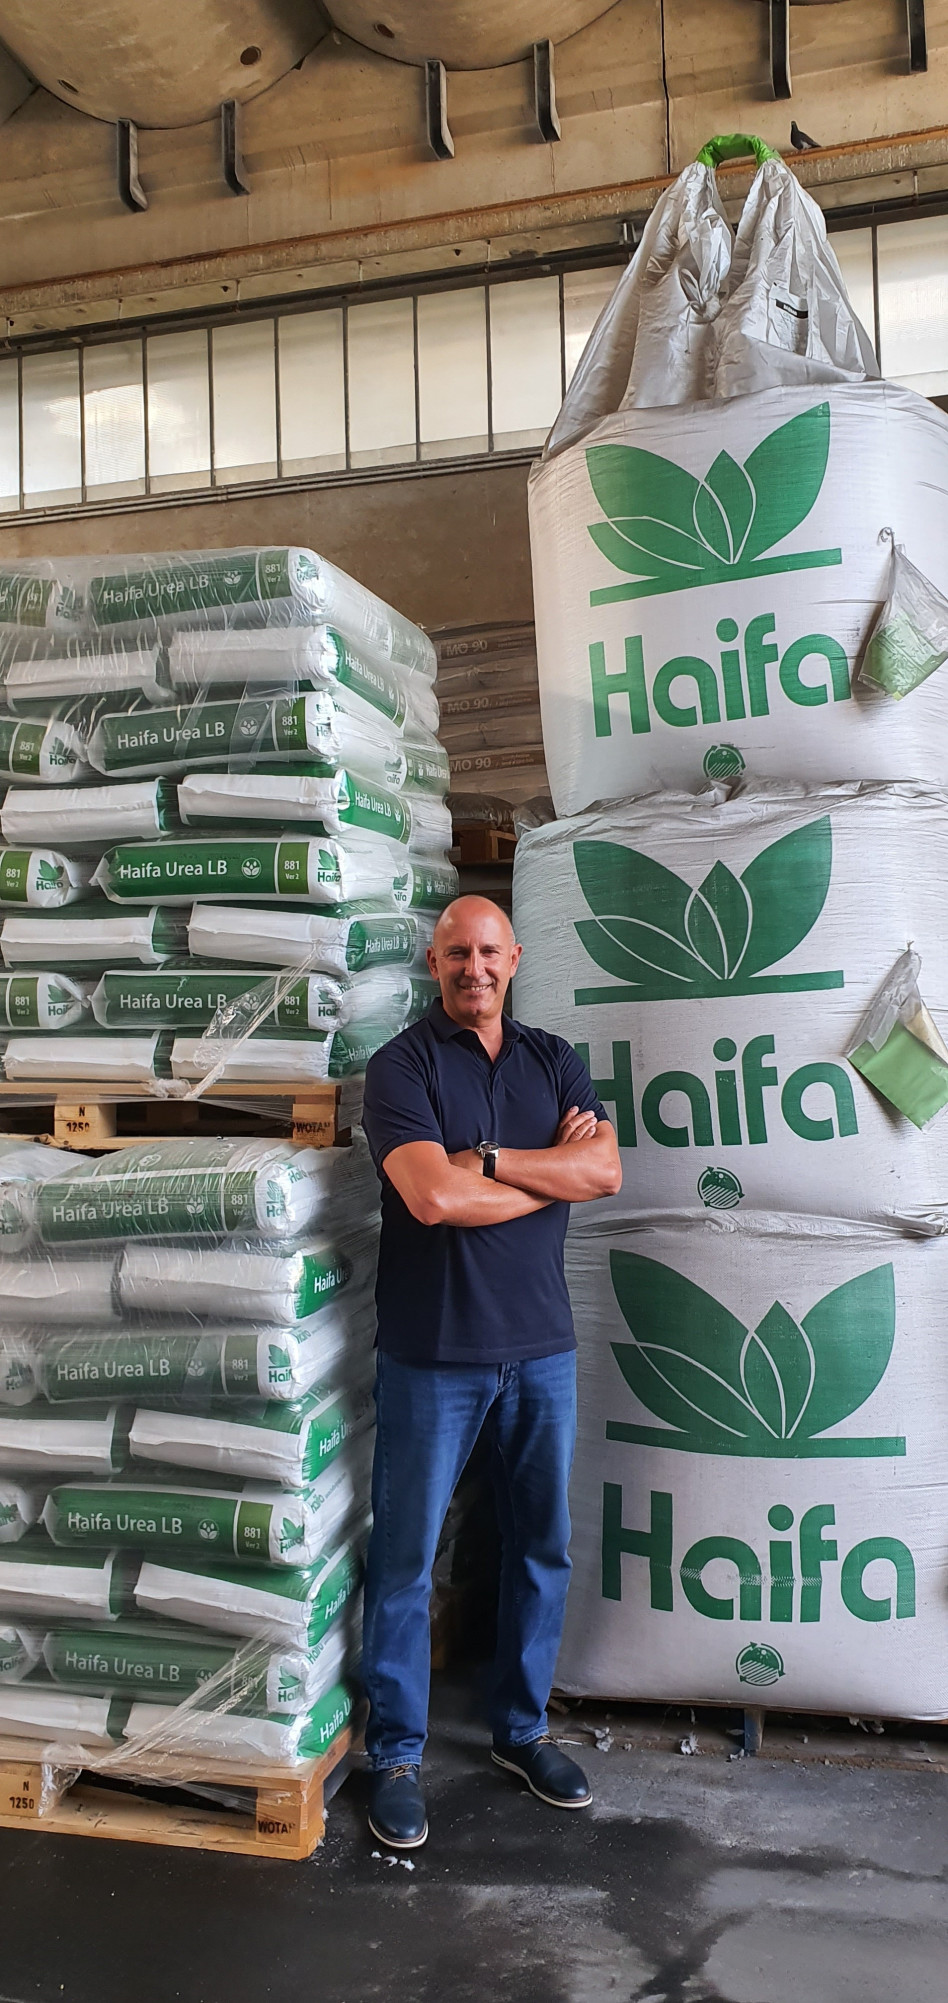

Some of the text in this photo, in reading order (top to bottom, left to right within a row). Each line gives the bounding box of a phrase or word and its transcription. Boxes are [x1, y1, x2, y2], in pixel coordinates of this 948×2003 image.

[265, 564, 280, 573] 881
[103, 574, 209, 604] Haifa Urea LB
[447, 643, 468, 657] MO
[472, 640, 488, 652] 90
[588, 612, 851, 737] Haifa
[447, 700, 470, 713] MO
[473, 697, 489, 709] 90
[282, 716, 298, 726] 881
[117, 722, 225, 749] Haifa Urea LB
[20, 741, 35, 751] 881
[450, 760, 472, 772] MO
[475, 757, 492, 769] 90
[355, 791, 391, 817] Haifa Urea LB
[6, 868, 21, 878] 881
[120, 860, 227, 880] Haifa Urea LB
[284, 861, 300, 871] 881
[365, 938, 381, 954] Haifa
[382, 938, 393, 951] Urea
[15, 996, 30, 1006] 881
[120, 993, 227, 1009] Haifa Urea LB
[284, 996, 300, 1006] 881
[575, 1034, 859, 1148] Haifa
[79, 1106, 85, 1116] N
[66, 1122, 90, 1132] 1250
[231, 1194, 247, 1205] 881
[53, 1197, 168, 1222] Haifa Urea LB
[314, 1270, 335, 1294] Haifa
[57, 1359, 170, 1381] Haifa Urea LB
[232, 1359, 249, 1370] 881
[320, 1430, 340, 1457] Haifa
[67, 1512, 183, 1535] Haifa Urea LB
[244, 1526, 261, 1539] 881
[245, 1541, 255, 1549] Ver
[601, 1481, 916, 1623] Haifa
[325, 1588, 346, 1620] Haifa
[65, 1651, 180, 1682] Haifa Urea LB
[320, 1709, 344, 1743] Haifa
[23, 1781, 30, 1791] N
[9, 1796, 35, 1809] 1250
